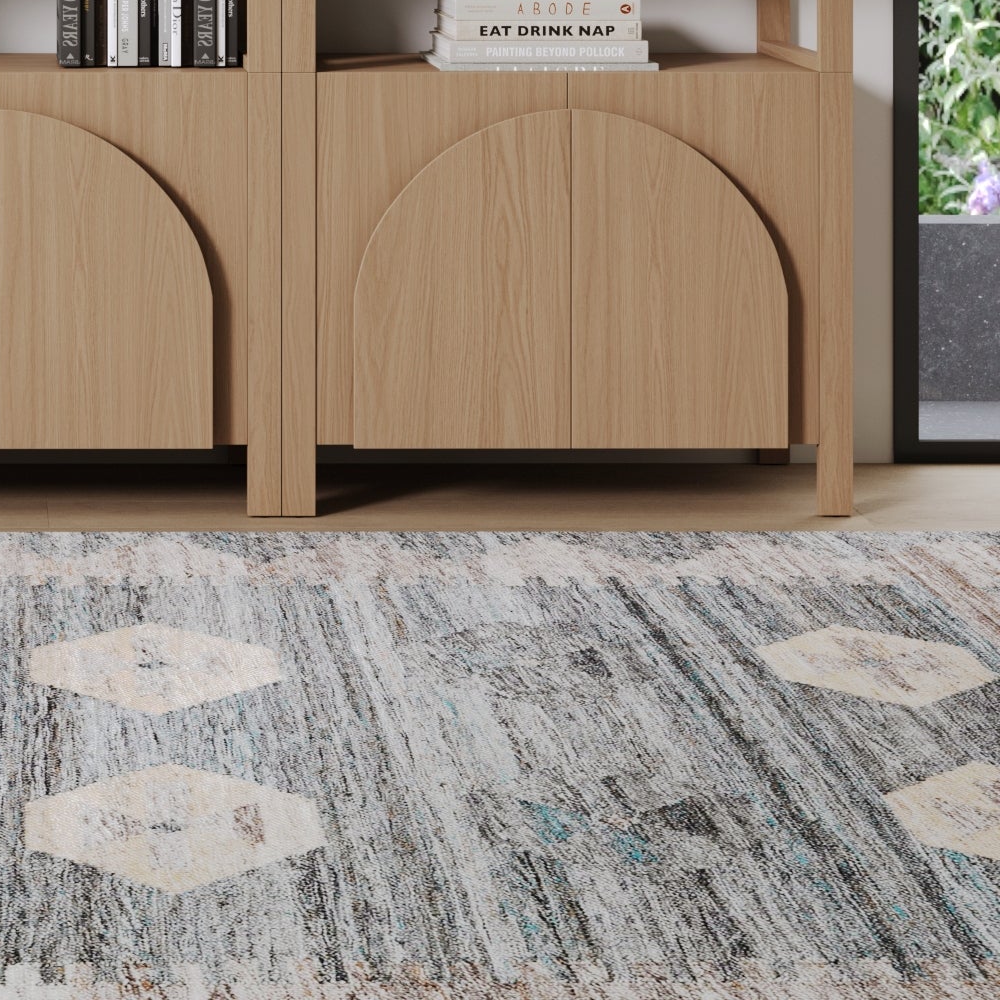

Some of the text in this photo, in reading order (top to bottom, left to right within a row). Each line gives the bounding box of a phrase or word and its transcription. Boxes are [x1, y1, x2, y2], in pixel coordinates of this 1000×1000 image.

[517, 2, 592, 15] ABODE
[173, 6, 181, 36] Dior
[479, 26, 616, 36] EAT DRINK NAP
[486, 47, 532, 57] PAINTING
[535, 47, 576, 57] BEYOND
[580, 47, 625, 57] POLLOCK
